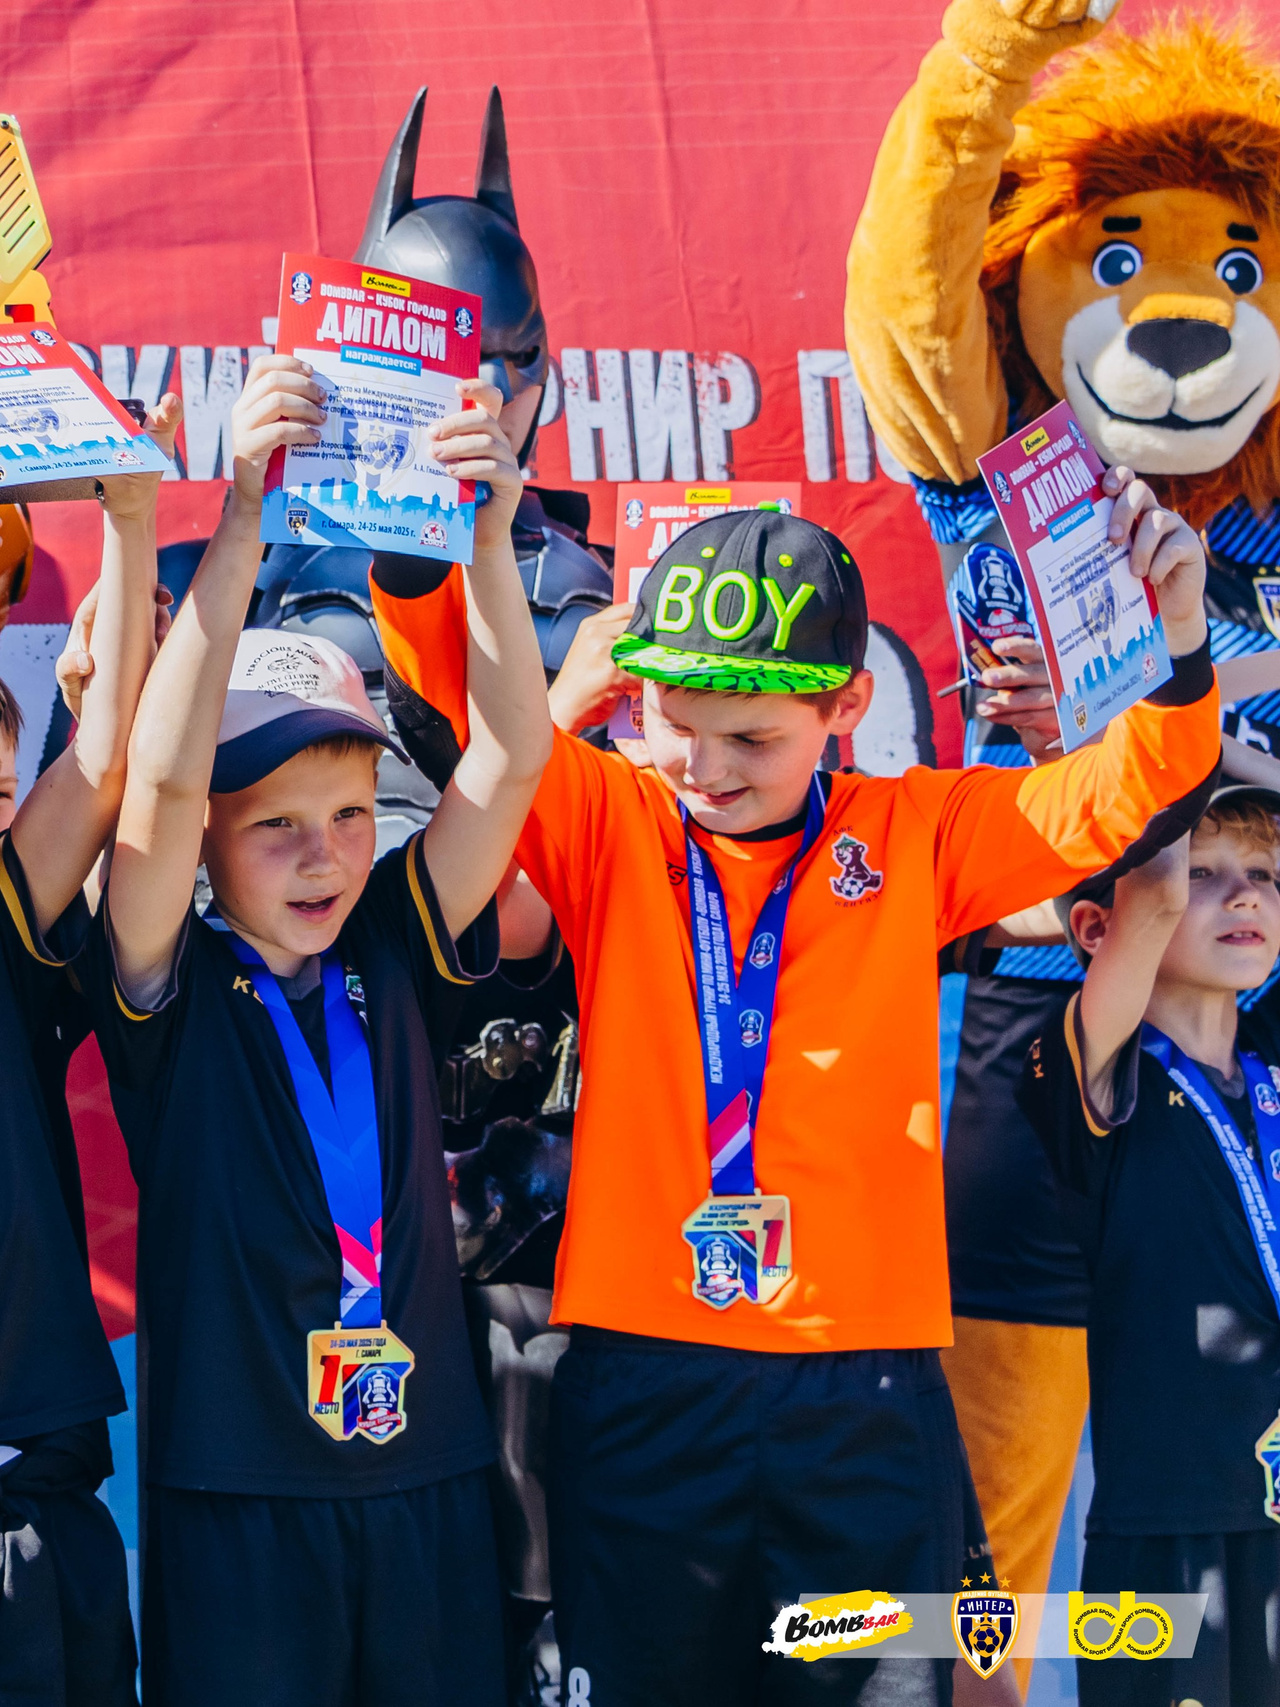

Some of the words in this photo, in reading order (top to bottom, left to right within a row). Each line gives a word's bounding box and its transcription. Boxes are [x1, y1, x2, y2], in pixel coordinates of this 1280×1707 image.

[376, 293, 405, 312] КУБОК
[407, 300, 447, 322] ГОРОДОВ
[317, 302, 446, 361] ДИПЛОМ
[346, 350, 417, 370] награждается:
[363, 388, 412, 403] Международном
[414, 398, 437, 409] турнире
[291, 449, 319, 458] Академии
[322, 451, 345, 460] футбола
[27, 464, 53, 472] Самара,
[1022, 452, 1097, 532] ДИПЛОМ
[328, 520, 356, 531] Самара,
[358, 521, 377, 532] 24-25
[378, 525, 391, 533] мая
[393, 525, 409, 536] 2025
[654, 565, 815, 651] BOY
[763, 1220, 784, 1268] 1
[762, 1265, 788, 1277] МЕСТО
[320, 1355, 341, 1404] 1
[314, 1402, 339, 1414] МЕСТО
